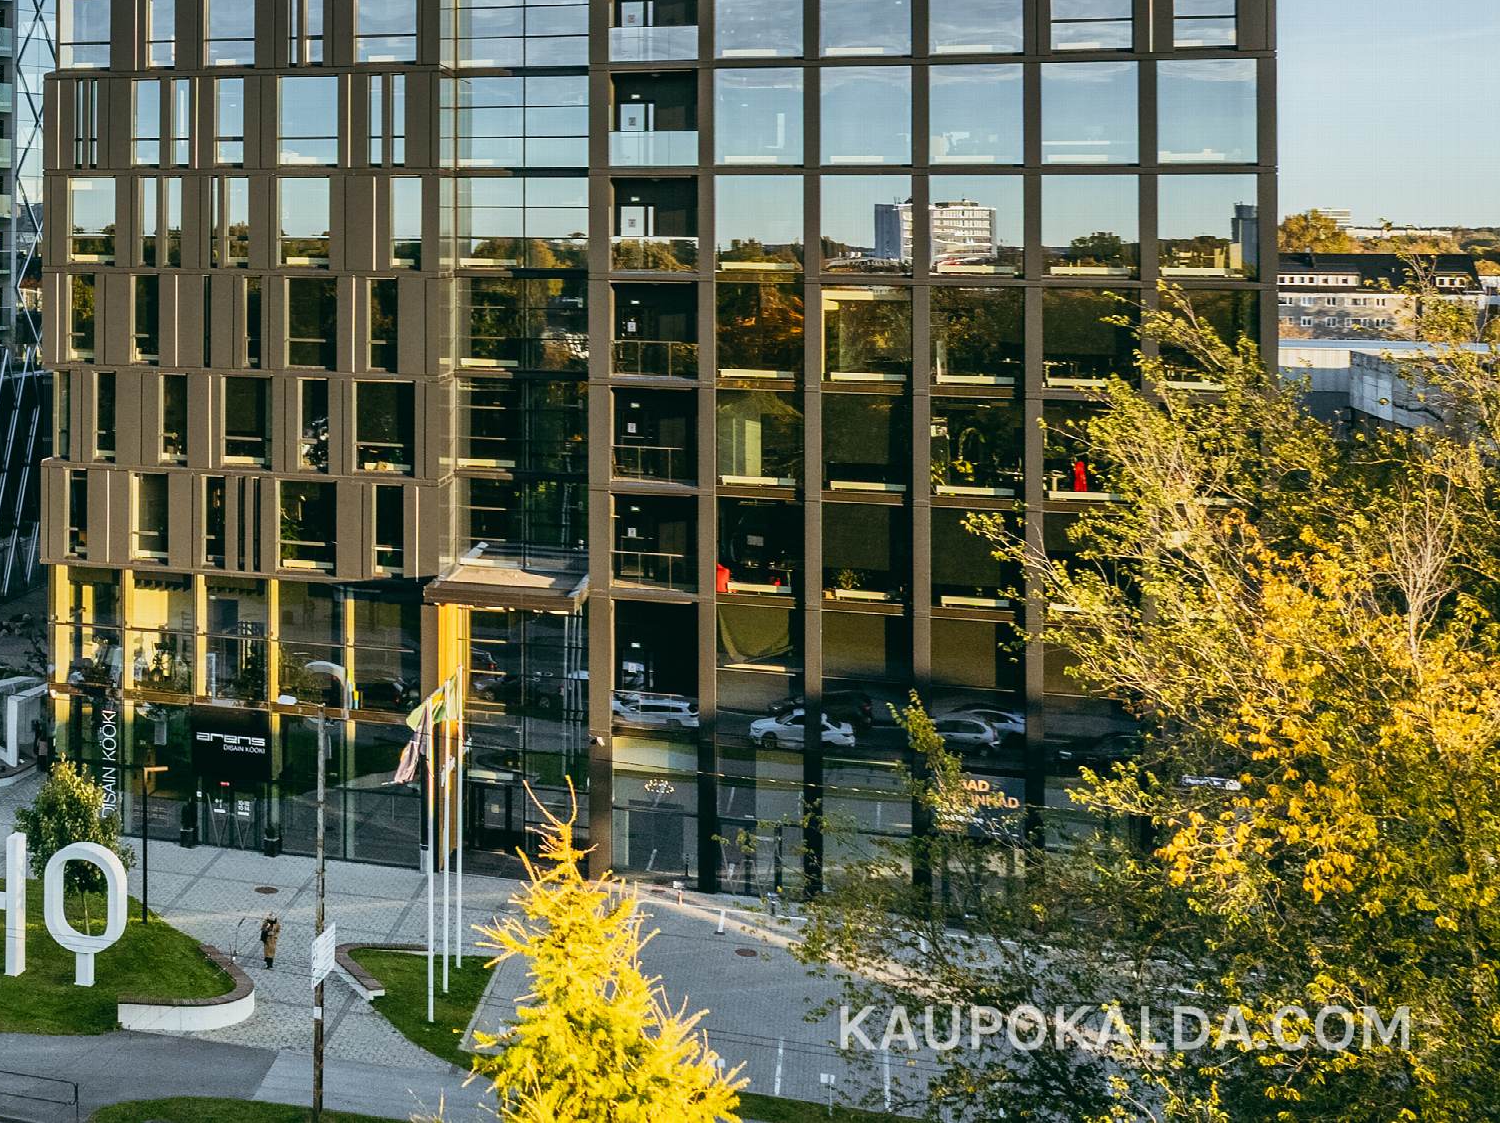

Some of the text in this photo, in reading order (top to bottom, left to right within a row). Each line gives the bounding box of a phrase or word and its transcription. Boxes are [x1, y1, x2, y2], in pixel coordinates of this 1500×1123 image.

[100, 709, 118, 818] DISAIN KÖÖKI
[196, 731, 266, 747] arens
